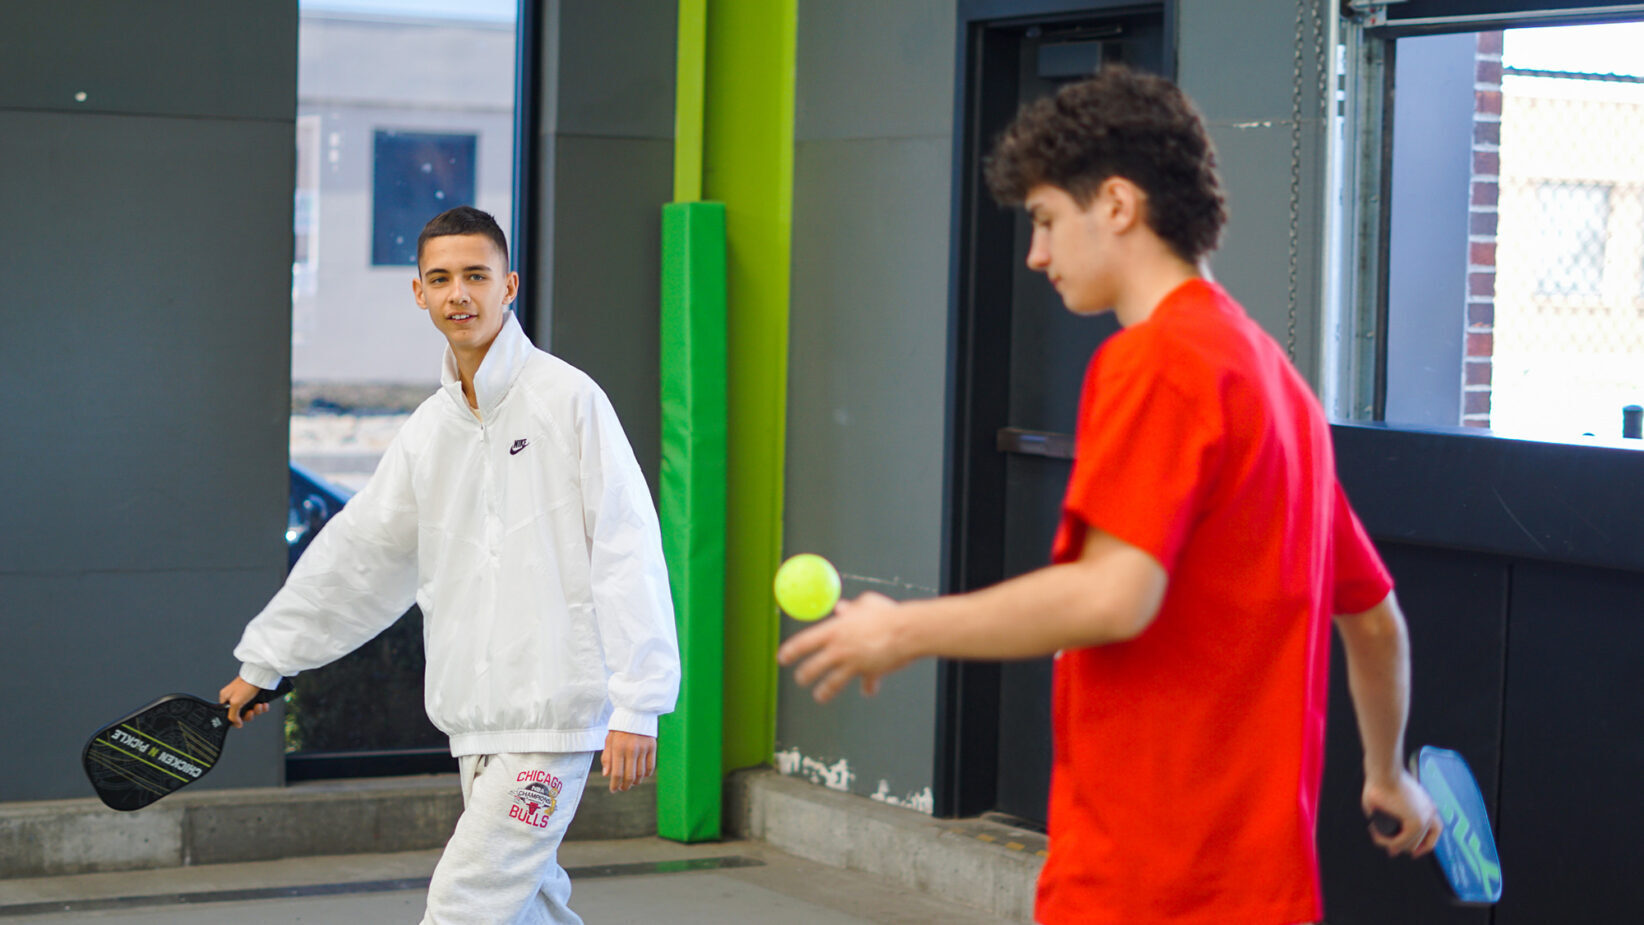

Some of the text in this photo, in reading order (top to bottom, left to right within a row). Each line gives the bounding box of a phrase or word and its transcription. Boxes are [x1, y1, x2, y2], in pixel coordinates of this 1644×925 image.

[149, 746, 158, 757] N
[158, 751, 203, 778] CHICKEN
[516, 769, 563, 795] CHICAGO
[531, 785, 545, 794] NBA
[509, 804, 550, 828] BULLS
